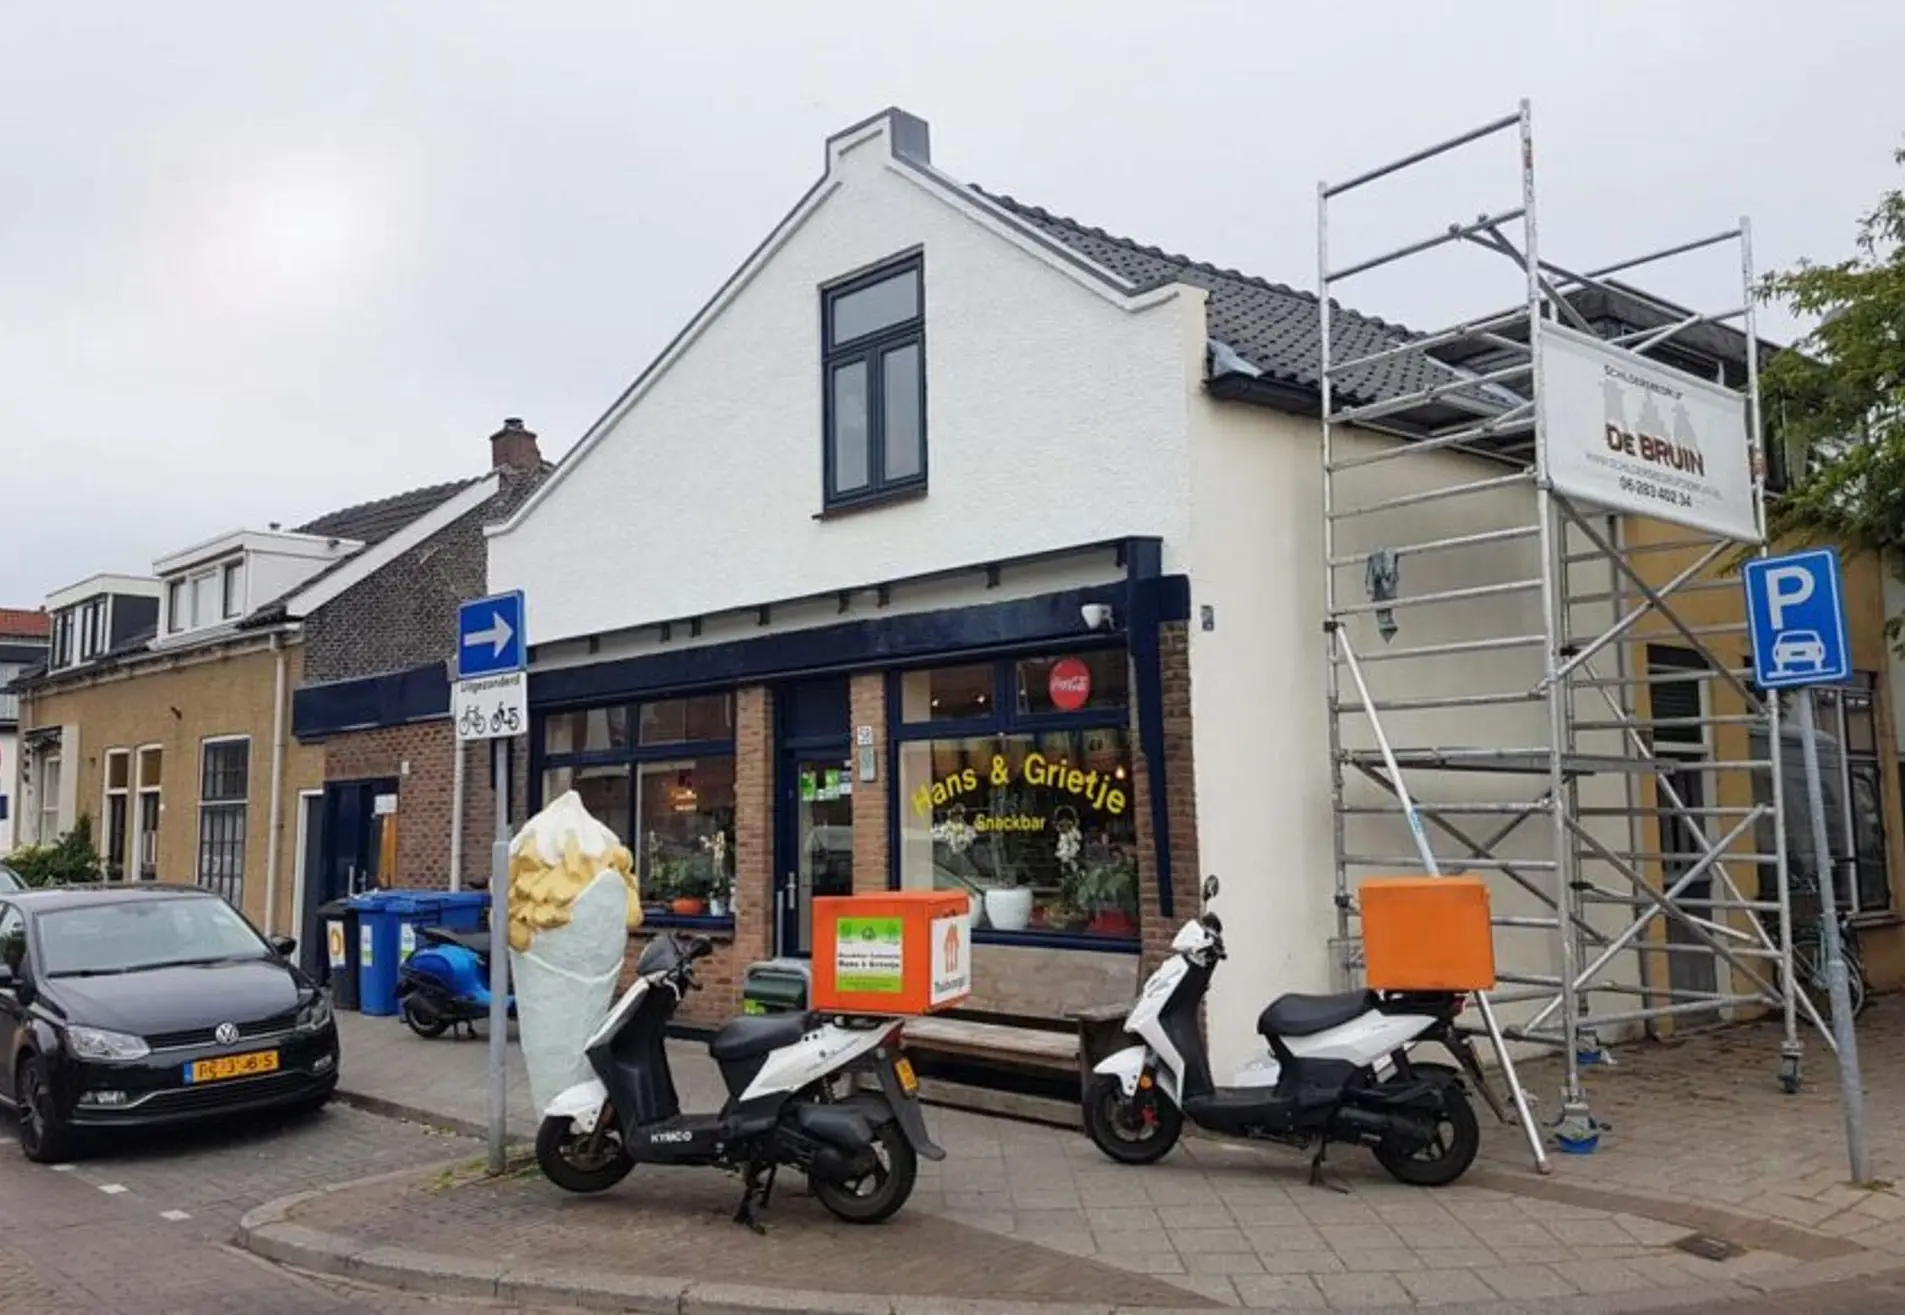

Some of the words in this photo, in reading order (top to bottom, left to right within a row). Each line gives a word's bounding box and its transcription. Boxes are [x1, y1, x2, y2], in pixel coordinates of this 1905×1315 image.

[1638, 433, 1705, 477] BRUIN
[1765, 565, 1815, 630] P
[911, 767, 978, 816] Hans
[990, 754, 1009, 786] &
[1023, 752, 1126, 815] Grietje
[973, 813, 1046, 832] Snackbar
